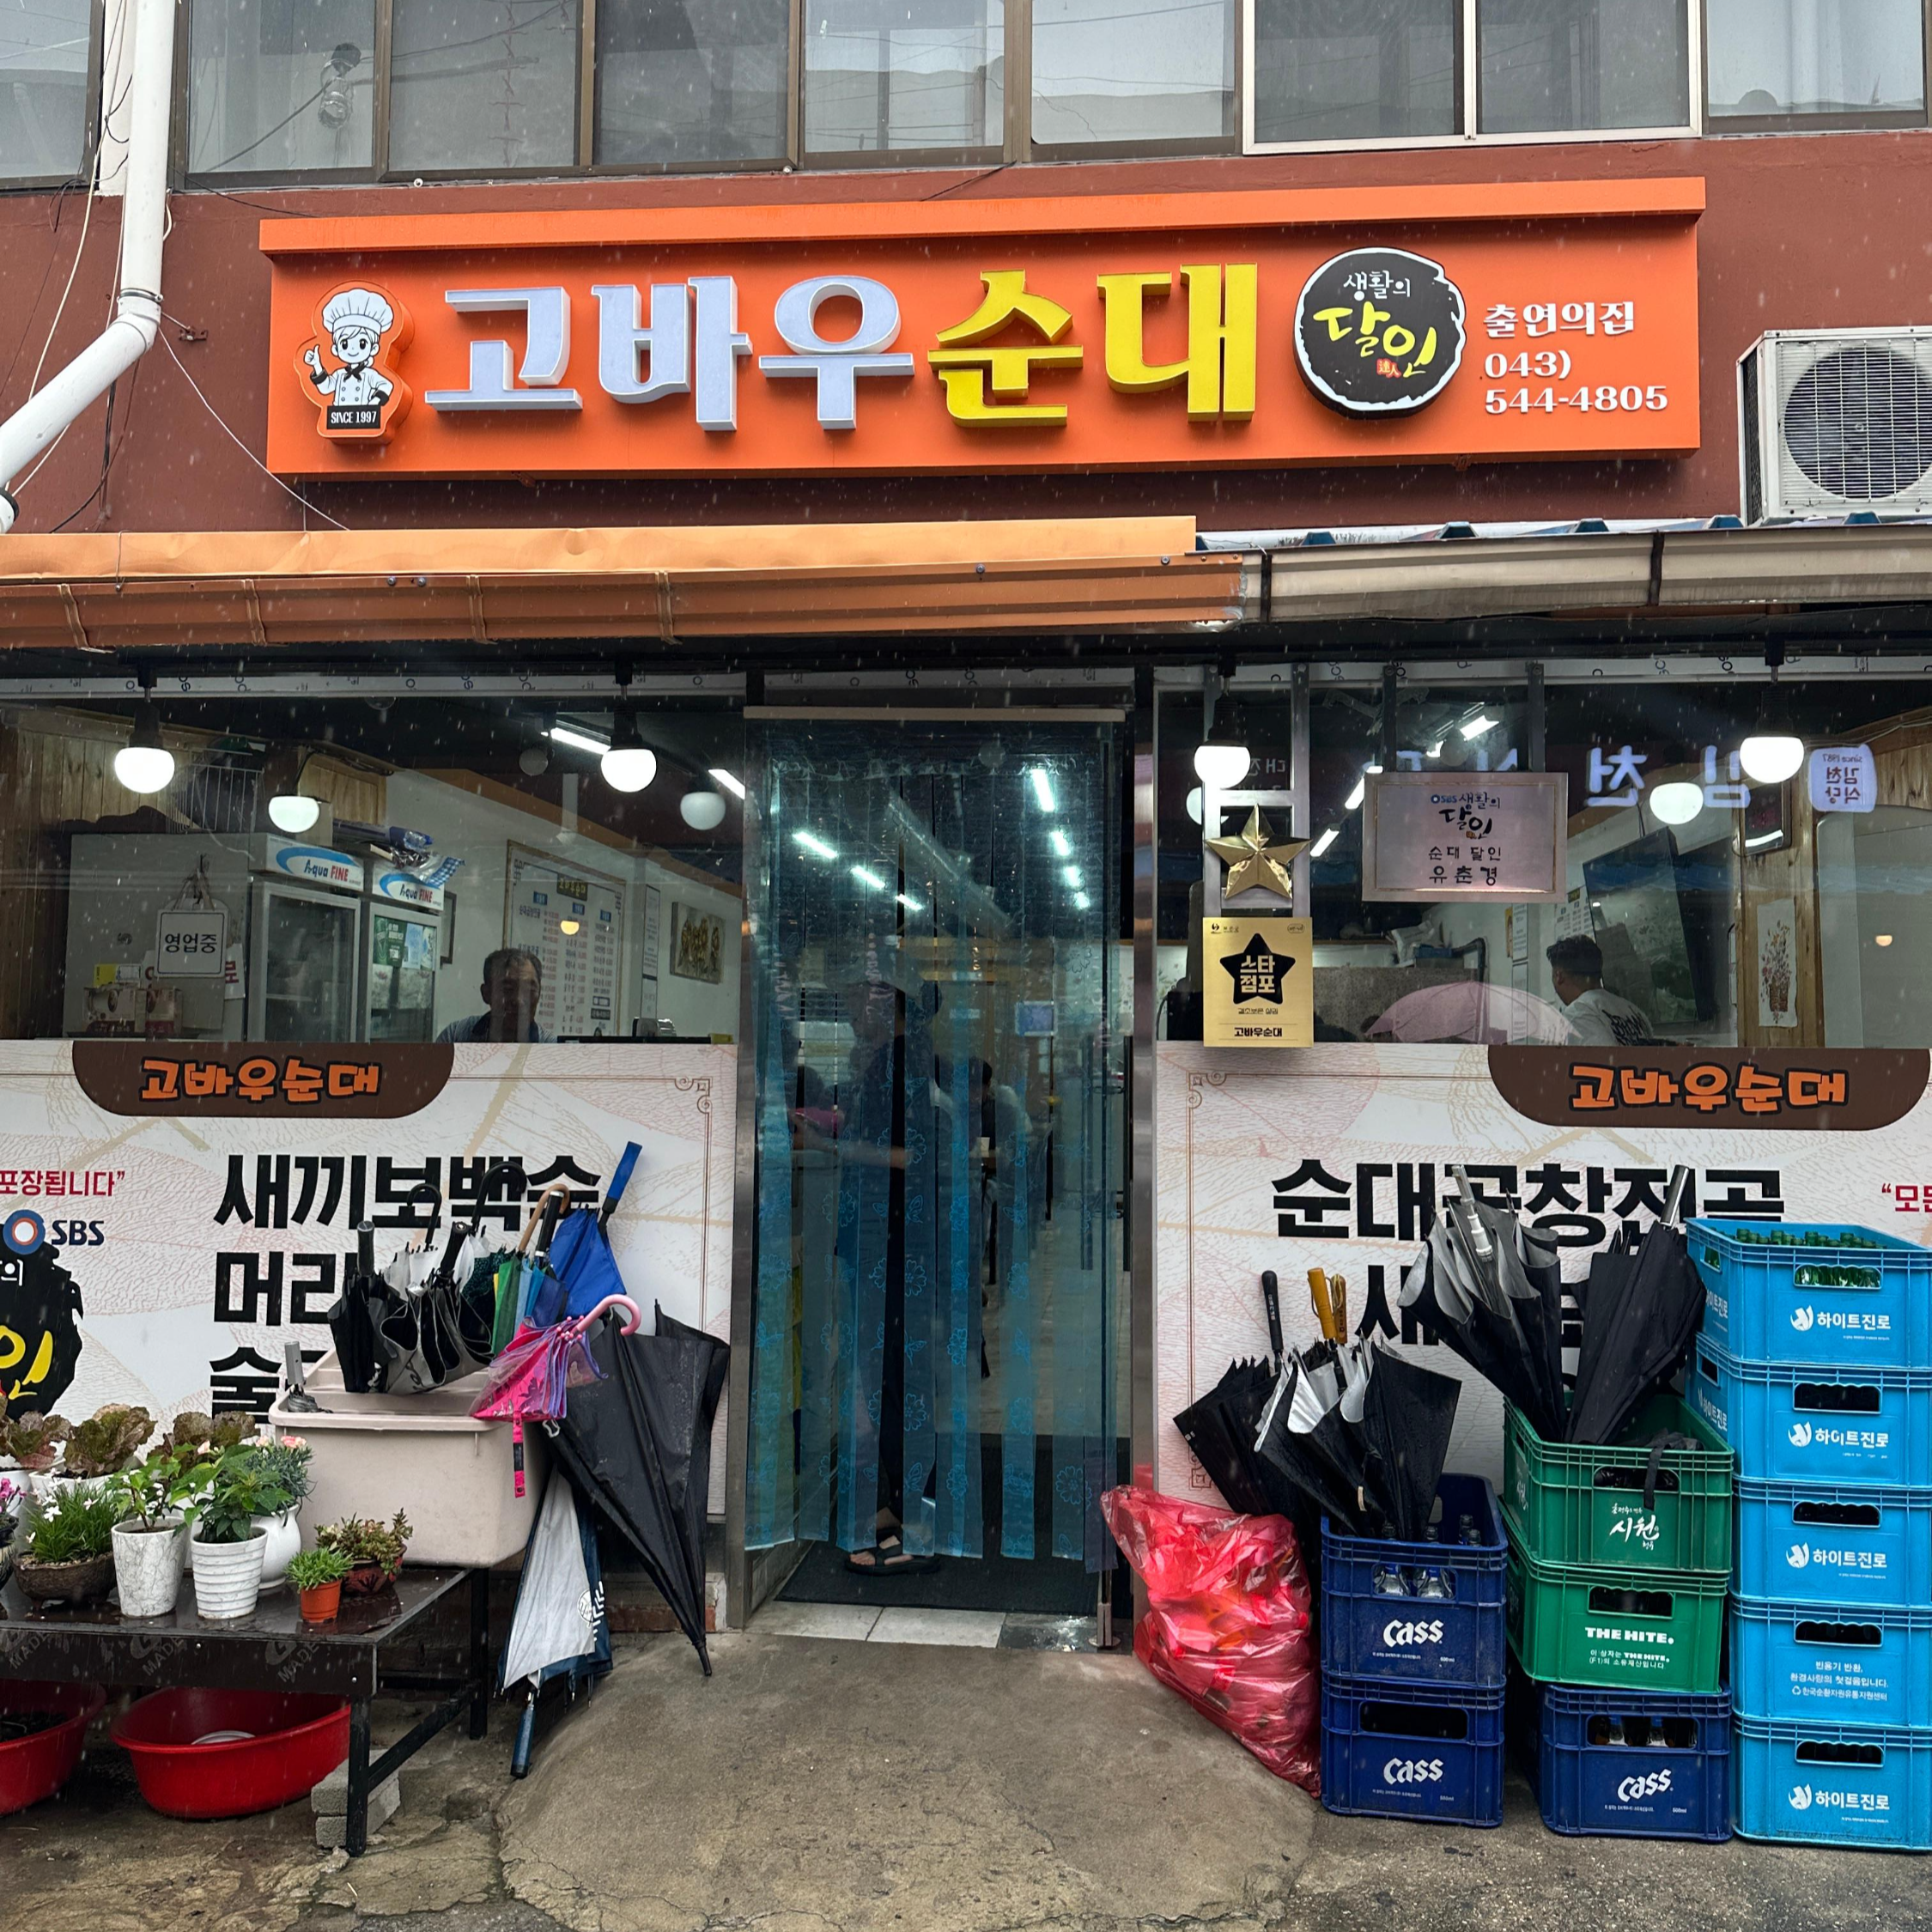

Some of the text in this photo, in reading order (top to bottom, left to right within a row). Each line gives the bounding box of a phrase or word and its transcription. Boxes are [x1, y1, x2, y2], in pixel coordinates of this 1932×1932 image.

[1343, 270, 1411, 301] 생활의
[1484, 301, 1635, 338] 출연의집
[1313, 301, 1437, 378] 달인
[1485, 349, 1572, 380] 043)
[1485, 385, 1668, 415] 544-4805
[331, 410, 377, 424] SINCE 1997
[1459, 792, 1501, 810] 생활의
[1438, 806, 1492, 840] 달인
[1428, 846, 1501, 861] 순대 달인
[331, 866, 349, 883] FINE
[419, 889, 433, 903] FINE
[164, 932, 218, 954] 영업중
[1240, 955, 1275, 973] 스타
[1240, 975, 1275, 993] 점포
[1234, 1027, 1283, 1037] 고바우순대
[139, 1057, 380, 1103] 고바우순대
[1571, 1064, 1847, 1113] 고바우순대
[51, 1219, 105, 1246] SBS
[1817, 1312, 1892, 1331] 하이트진로
[1814, 1428, 1889, 1449] 하이트진로
[1813, 1548, 1887, 1570] 하이트진로
[1585, 1627, 1621, 1640] THE
[142, 1636, 185, 1677] MADE
[277, 1642, 320, 1683] MADE
[1815, 1790, 1890, 1811] 하이트진로
